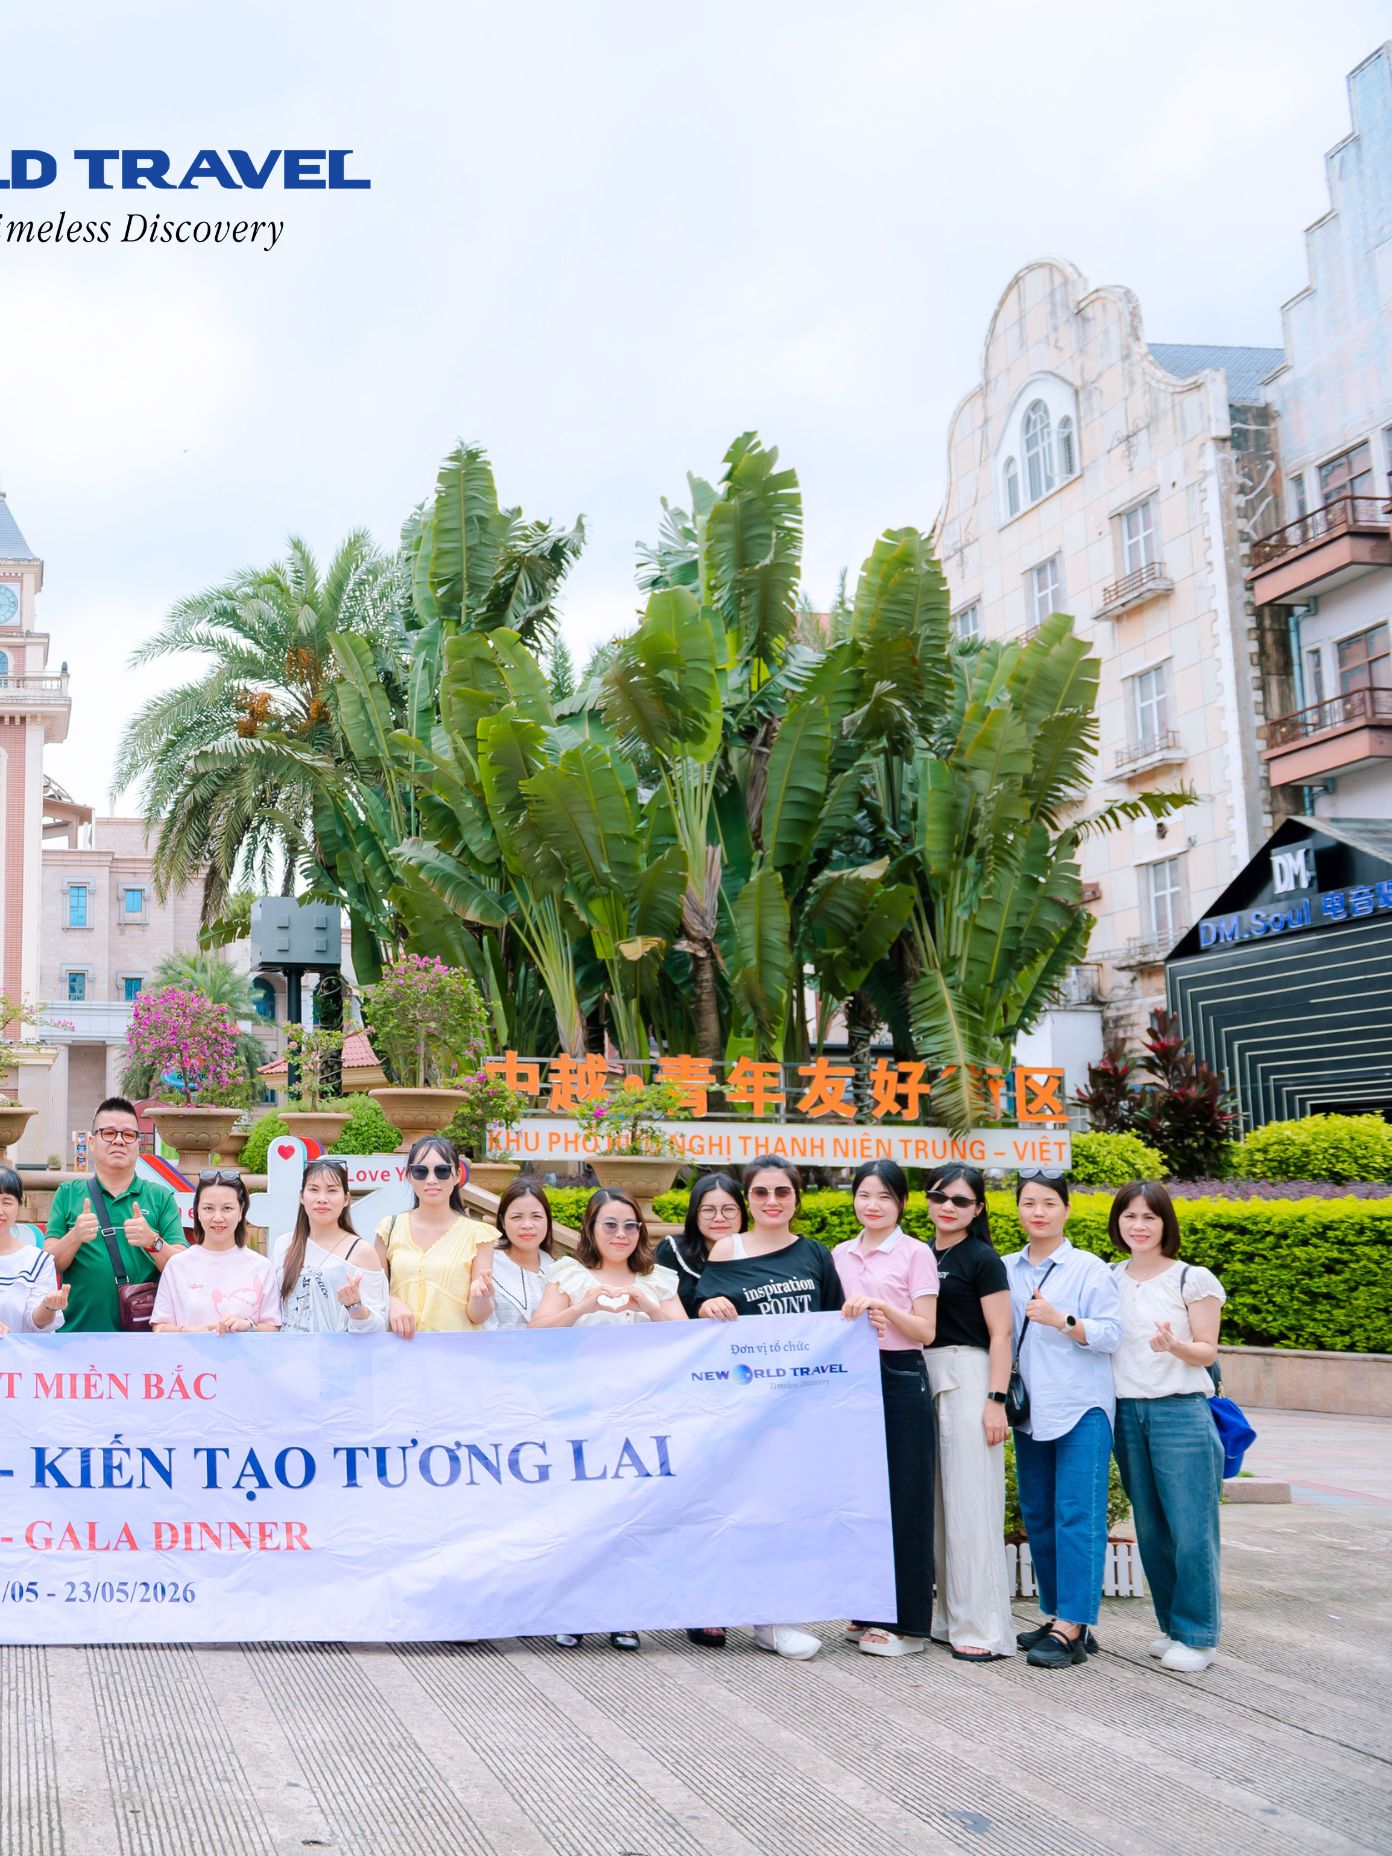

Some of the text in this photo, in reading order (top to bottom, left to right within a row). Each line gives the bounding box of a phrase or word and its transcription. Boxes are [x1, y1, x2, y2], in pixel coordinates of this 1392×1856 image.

[1199, 898, 1311, 947] DM.Soul
[488, 1130, 540, 1152] KHU
[670, 1134, 731, 1161] NGHỊ
[739, 1135, 825, 1158] THANH
[833, 1132, 891, 1159] NIÊN
[899, 1138, 986, 1160] TRUNG
[1013, 1136, 1068, 1165] VIỆT
[346, 1167, 391, 1182] Love
[743, 1275, 815, 1303] inspiration
[757, 1294, 813, 1315] POINT
[731, 1340, 810, 1355] Đơn vị tổ chức
[33, 1364, 131, 1401] MIỀN
[141, 1364, 218, 1401] BẮC
[790, 1363, 848, 1377] TRAVEL
[30, 1433, 175, 1490] KIẾN
[193, 1446, 317, 1502] TẠO
[333, 1438, 553, 1489] TƯƠNG
[567, 1435, 677, 1482] LAI
[24, 1520, 140, 1552] GALA
[151, 1521, 313, 1552] DINNER
[64, 1581, 196, 1605] 23/05/2026
